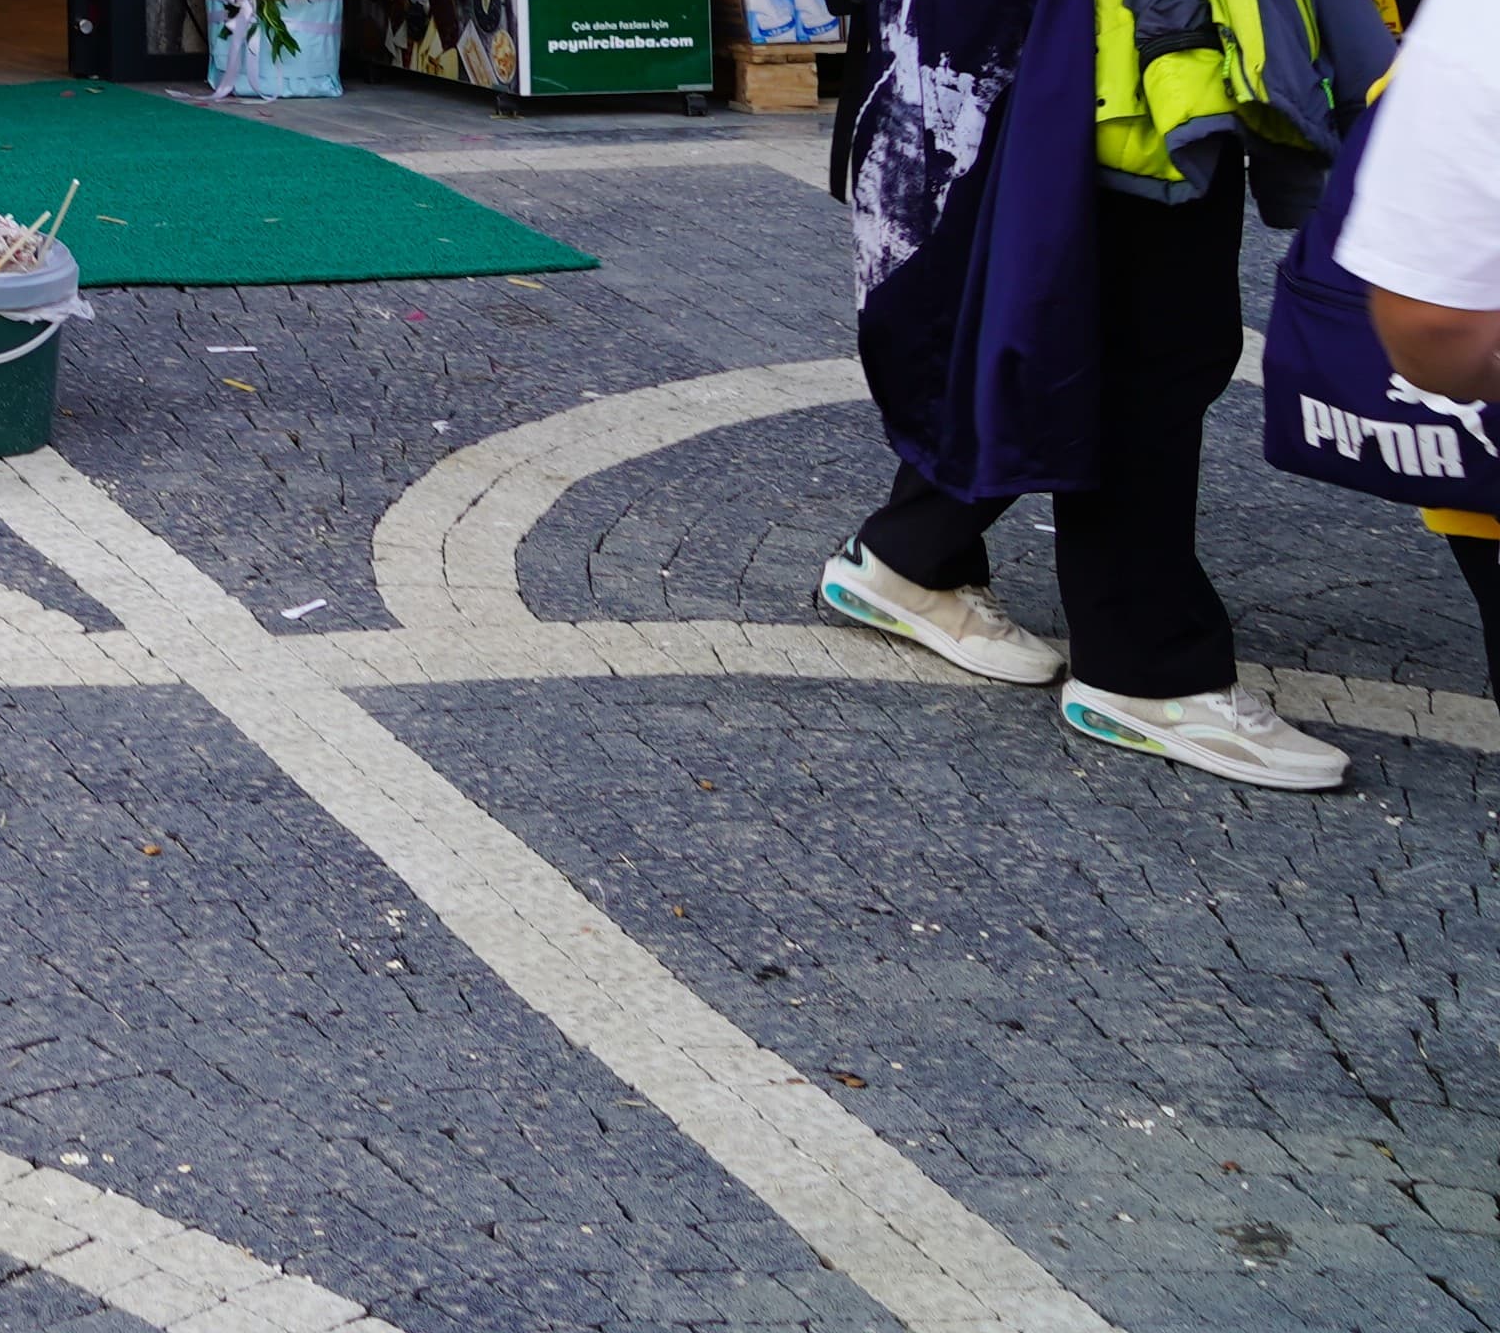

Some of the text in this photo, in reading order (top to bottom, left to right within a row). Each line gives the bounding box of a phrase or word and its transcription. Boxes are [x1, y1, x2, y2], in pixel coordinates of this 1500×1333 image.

[571, 19, 669, 32] Çok daha fazlası için
[548, 35, 694, 53] peynircibaba.com
